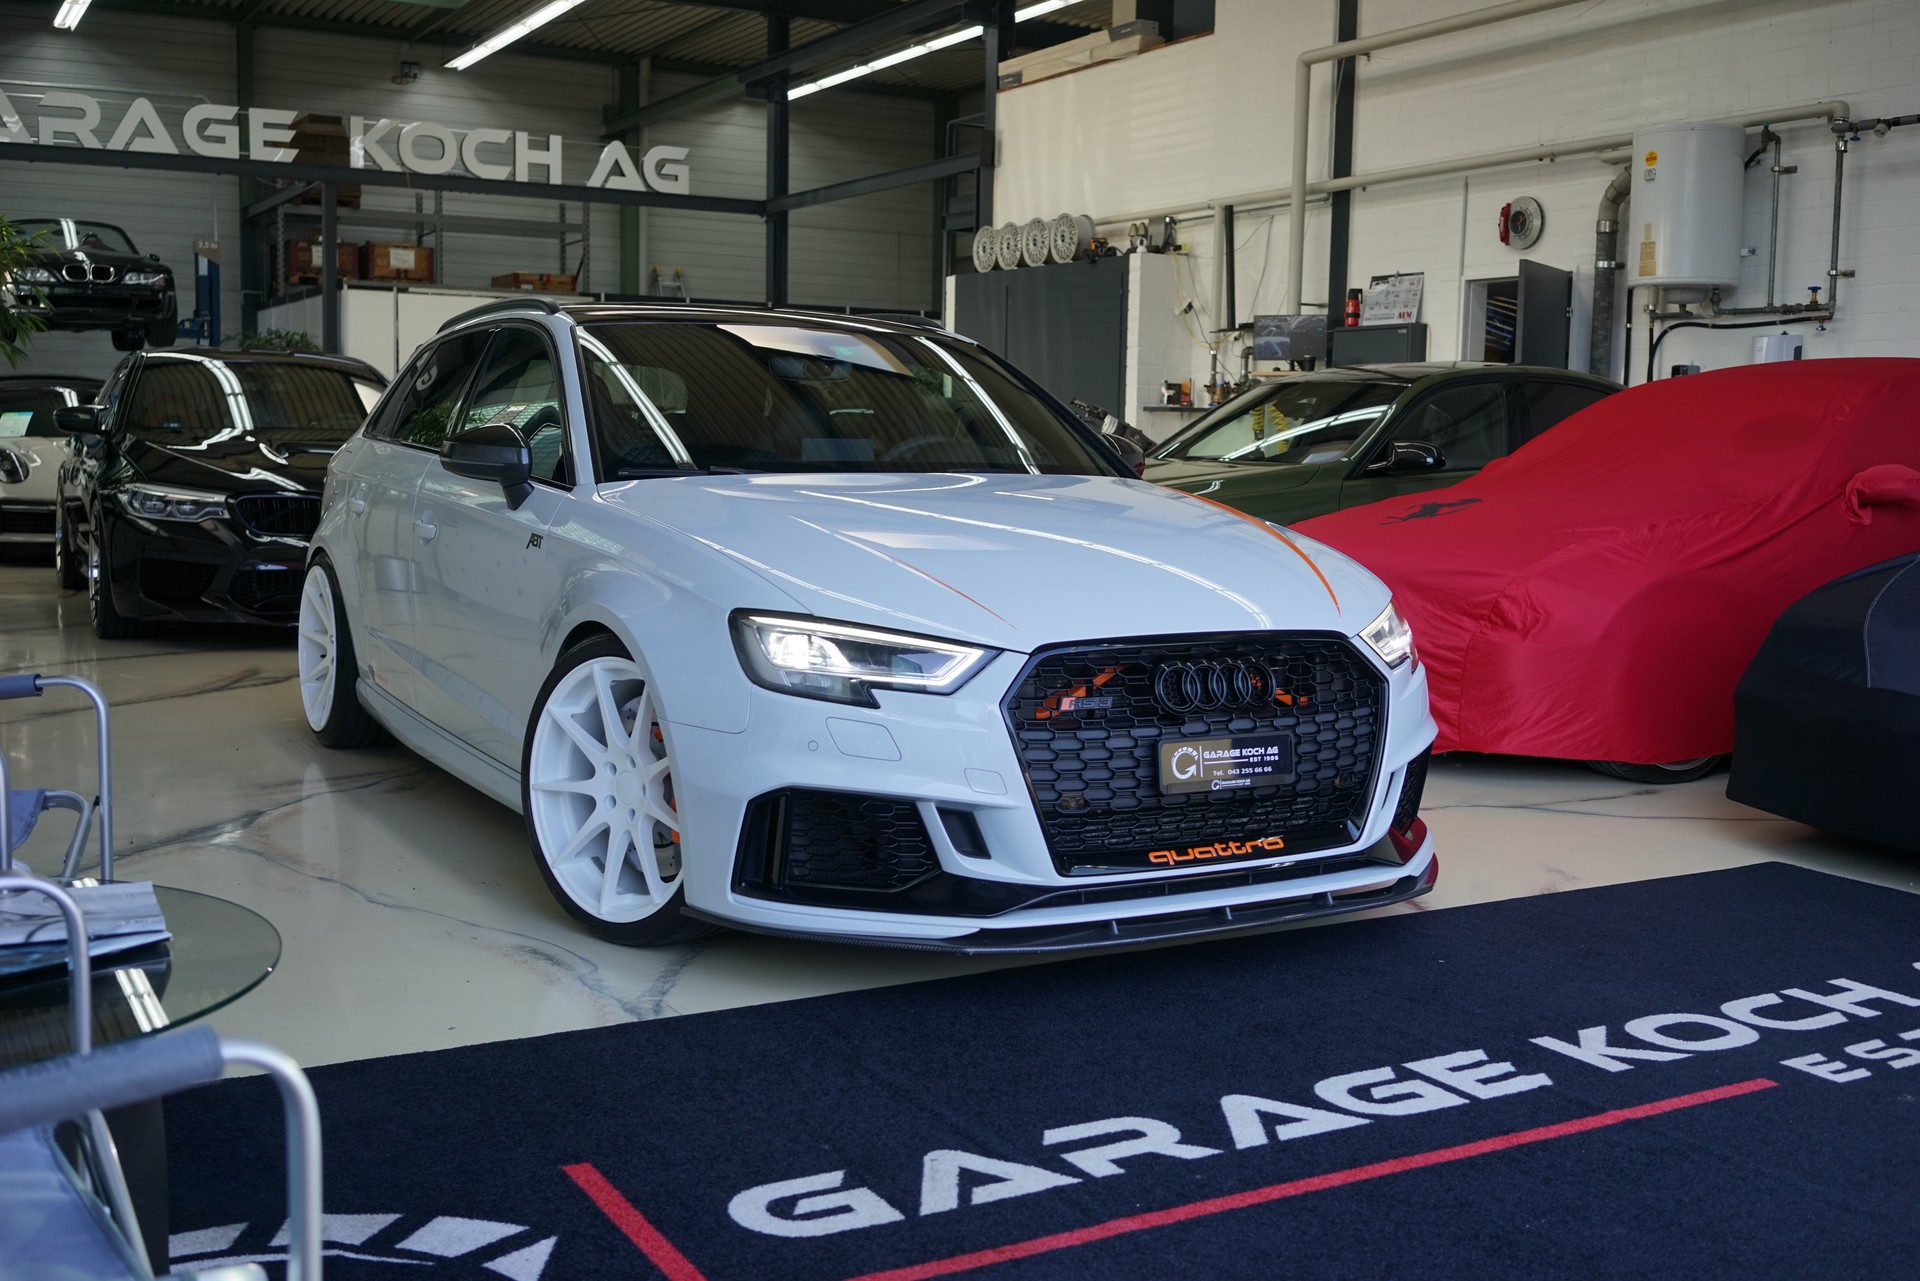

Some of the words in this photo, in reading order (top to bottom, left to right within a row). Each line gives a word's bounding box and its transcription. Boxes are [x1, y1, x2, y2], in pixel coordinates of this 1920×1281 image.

[0, 88, 299, 163] ARAGE
[350, 115, 562, 186] KOCH
[587, 140, 690, 195] AG
[1203, 749, 1241, 759] GARAGE
[1242, 747, 1265, 756] KOCH
[1266, 746, 1279, 755] AG
[1148, 836, 1285, 866] quattro
[727, 1049, 1553, 1238] GARAGE
[1527, 977, 1920, 1073] KOCH
